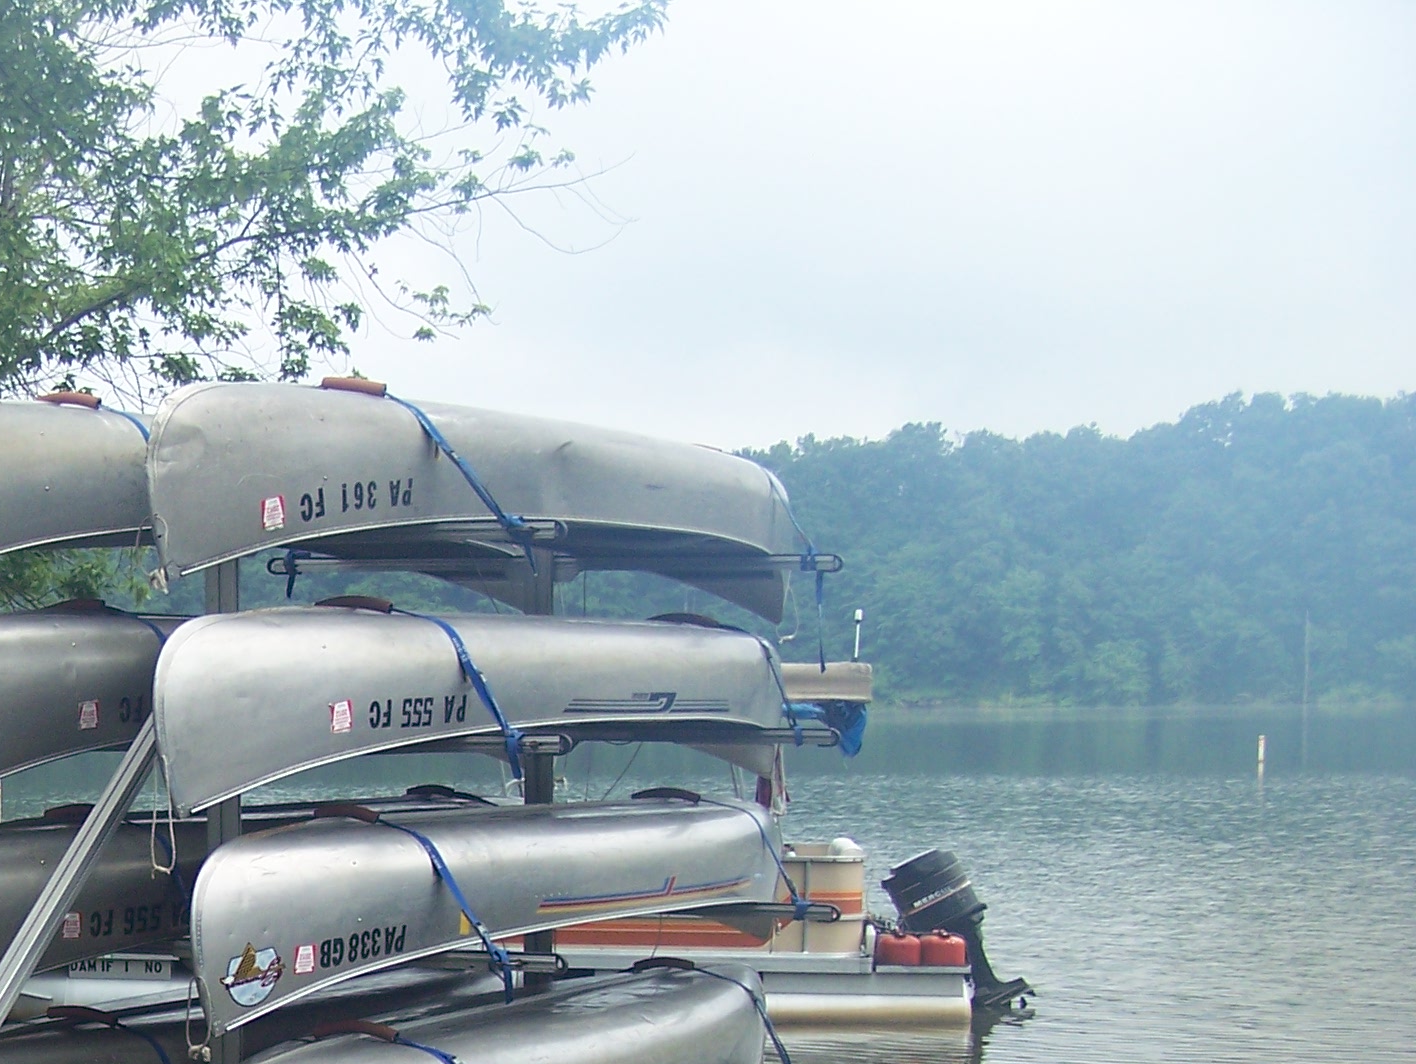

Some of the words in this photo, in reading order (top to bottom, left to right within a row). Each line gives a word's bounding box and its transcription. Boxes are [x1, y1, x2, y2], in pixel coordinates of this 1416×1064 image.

[299, 487, 326, 523] FC
[341, 480, 378, 513] 361
[389, 477, 414, 508] PA
[369, 699, 393, 729] FC
[400, 697, 434, 729] 555
[444, 694, 468, 724] PA
[89, 909, 114, 938] FC
[123, 904, 161, 936] 556
[319, 938, 344, 969] GB
[347, 928, 382, 963] 338
[384, 924, 407, 956] PA
